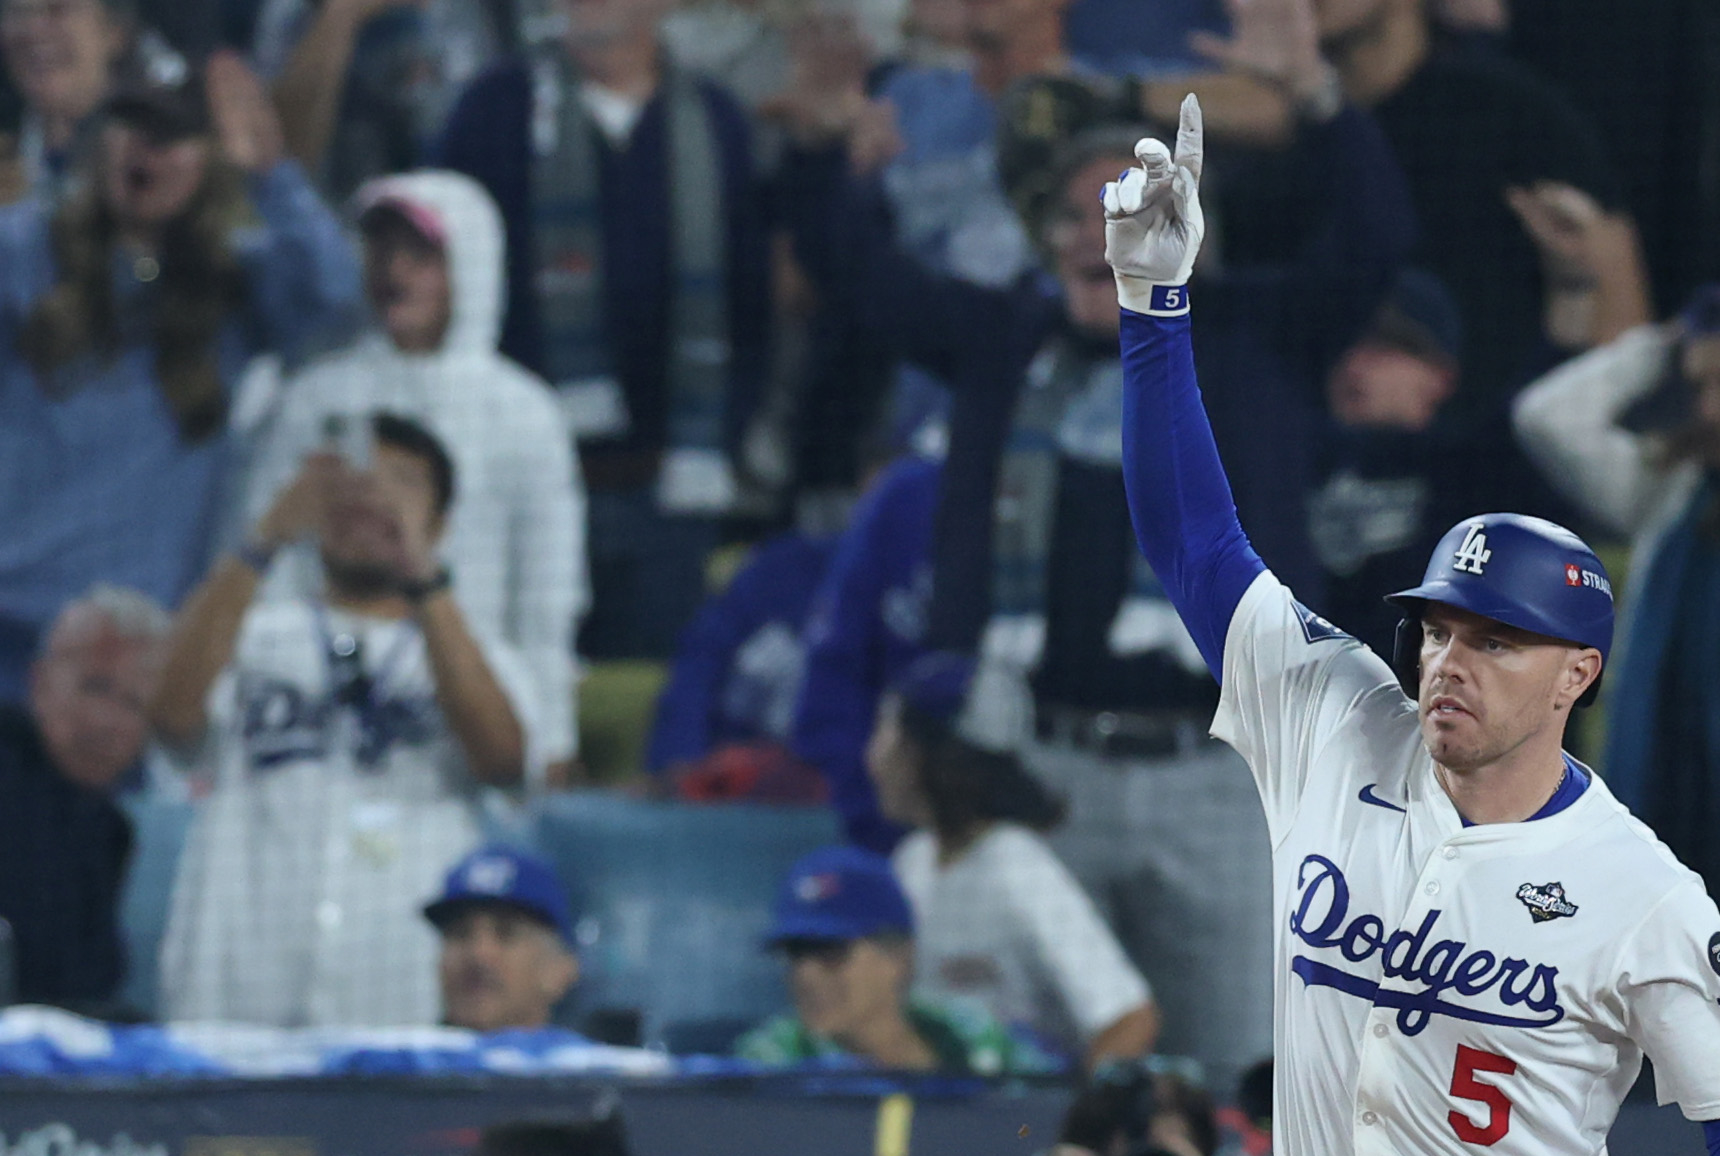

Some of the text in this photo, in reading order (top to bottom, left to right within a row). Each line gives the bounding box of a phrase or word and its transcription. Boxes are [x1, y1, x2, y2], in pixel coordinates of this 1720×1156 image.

[1165, 289, 1180, 308] 5
[1453, 523, 1492, 575] LA
[1290, 854, 1564, 1036] Dodgers
[1448, 1043, 1518, 1146] 5
